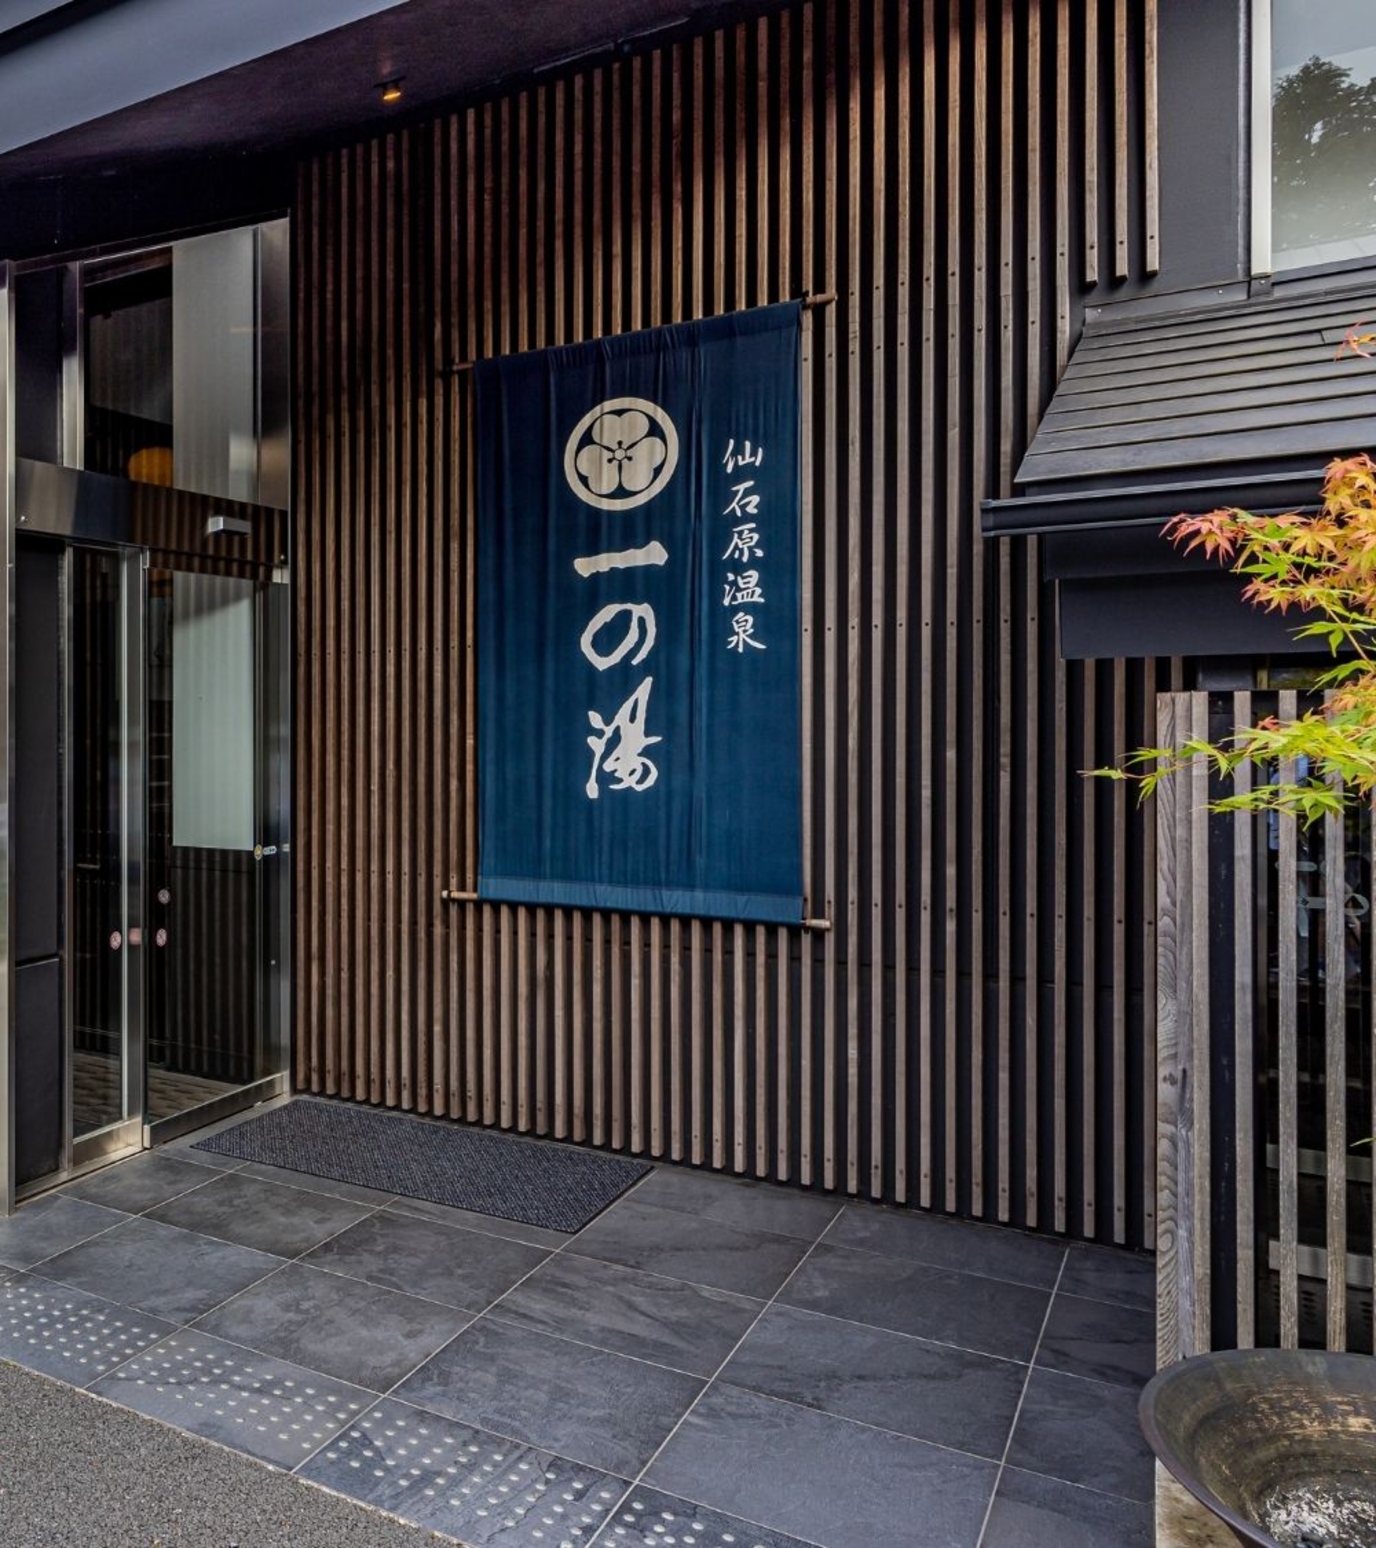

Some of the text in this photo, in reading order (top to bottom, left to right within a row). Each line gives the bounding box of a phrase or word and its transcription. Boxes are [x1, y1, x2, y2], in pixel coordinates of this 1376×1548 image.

[722, 438, 767, 653] 仙石原温泉
[573, 540, 669, 799] 一の湯
